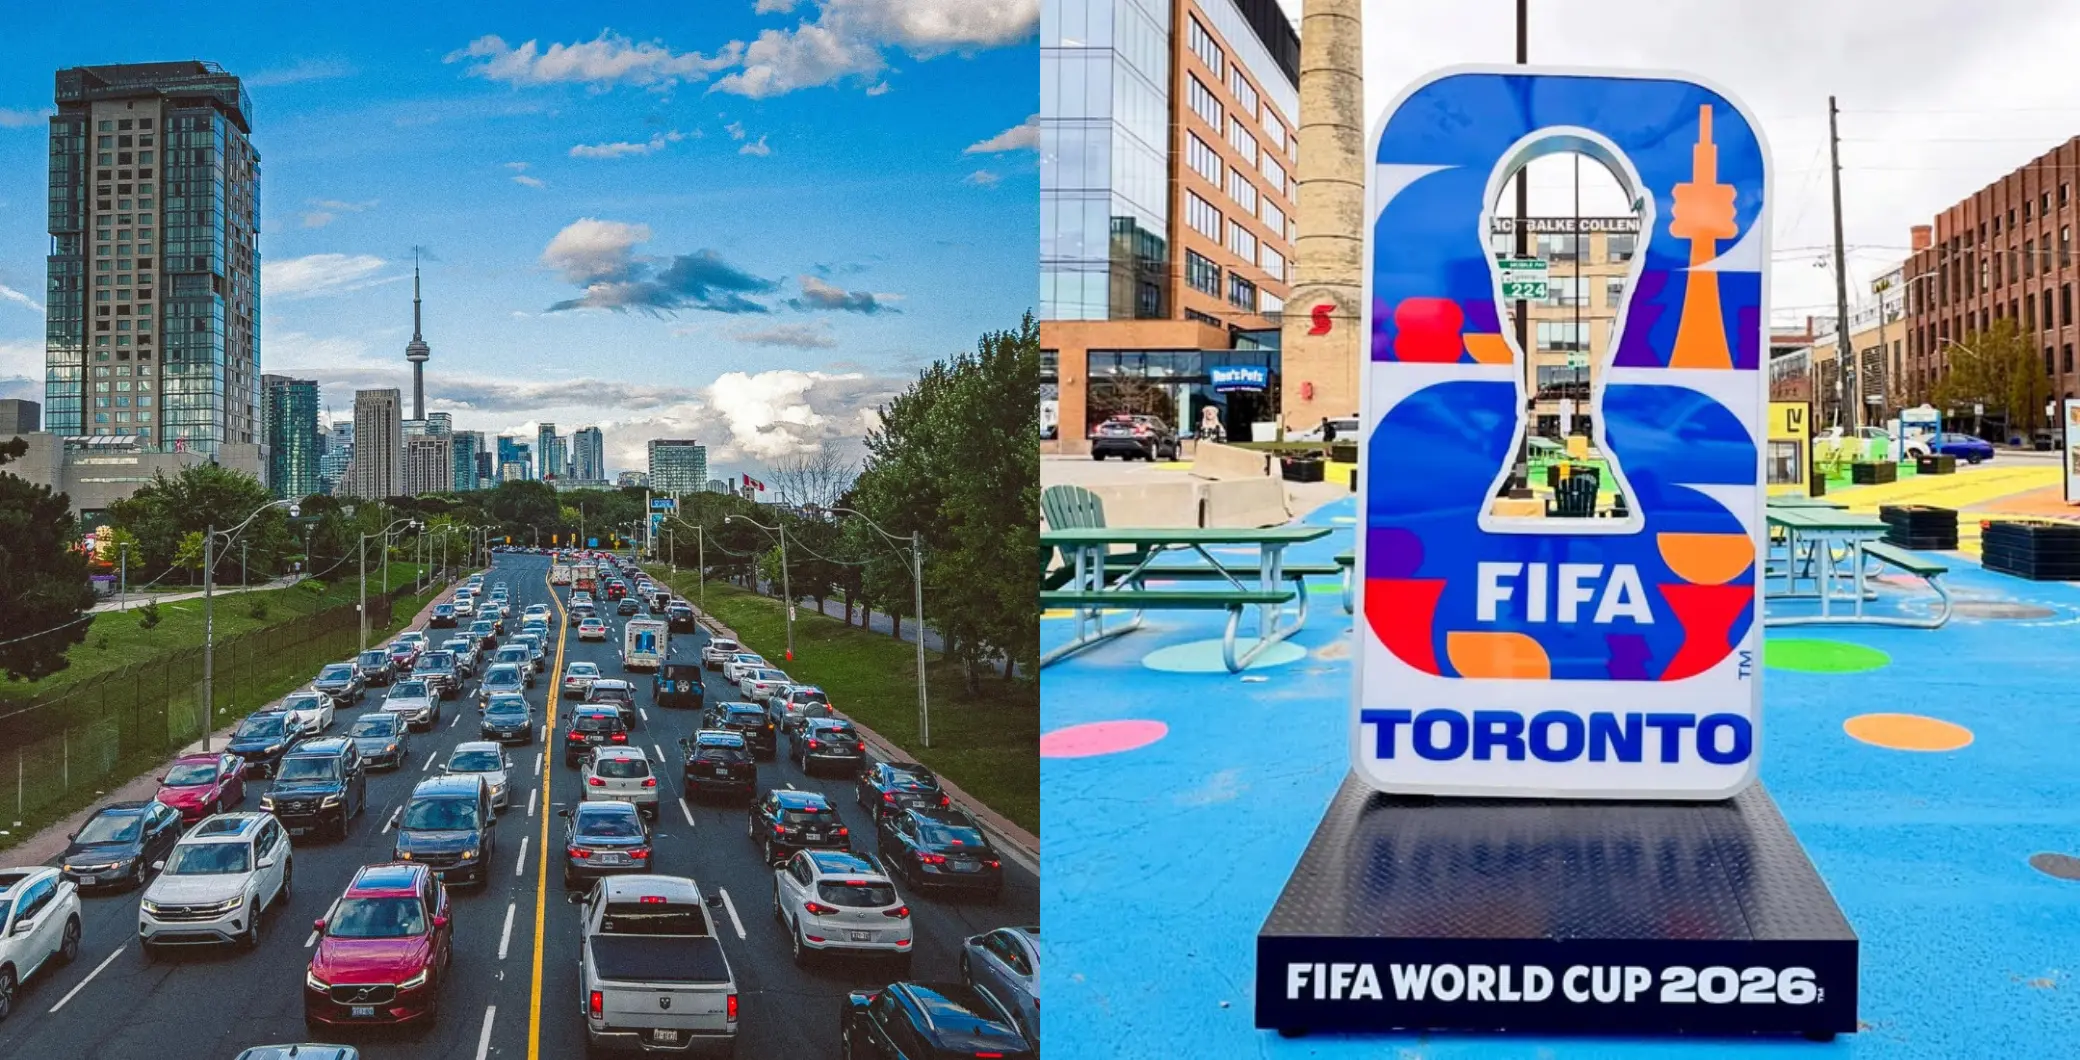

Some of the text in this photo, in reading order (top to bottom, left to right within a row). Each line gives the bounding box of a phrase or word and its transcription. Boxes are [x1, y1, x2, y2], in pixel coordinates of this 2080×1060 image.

[1511, 283, 1546, 297] 224
[1477, 561, 1655, 624] FIFA
[1738, 650, 1752, 681] TM
[1361, 708, 1752, 765] TORONTO
[1287, 962, 1383, 1000] FIFA
[1389, 963, 1554, 1002] WORLD
[1562, 965, 1652, 1003] CUP
[1660, 965, 1817, 1005] 2026
